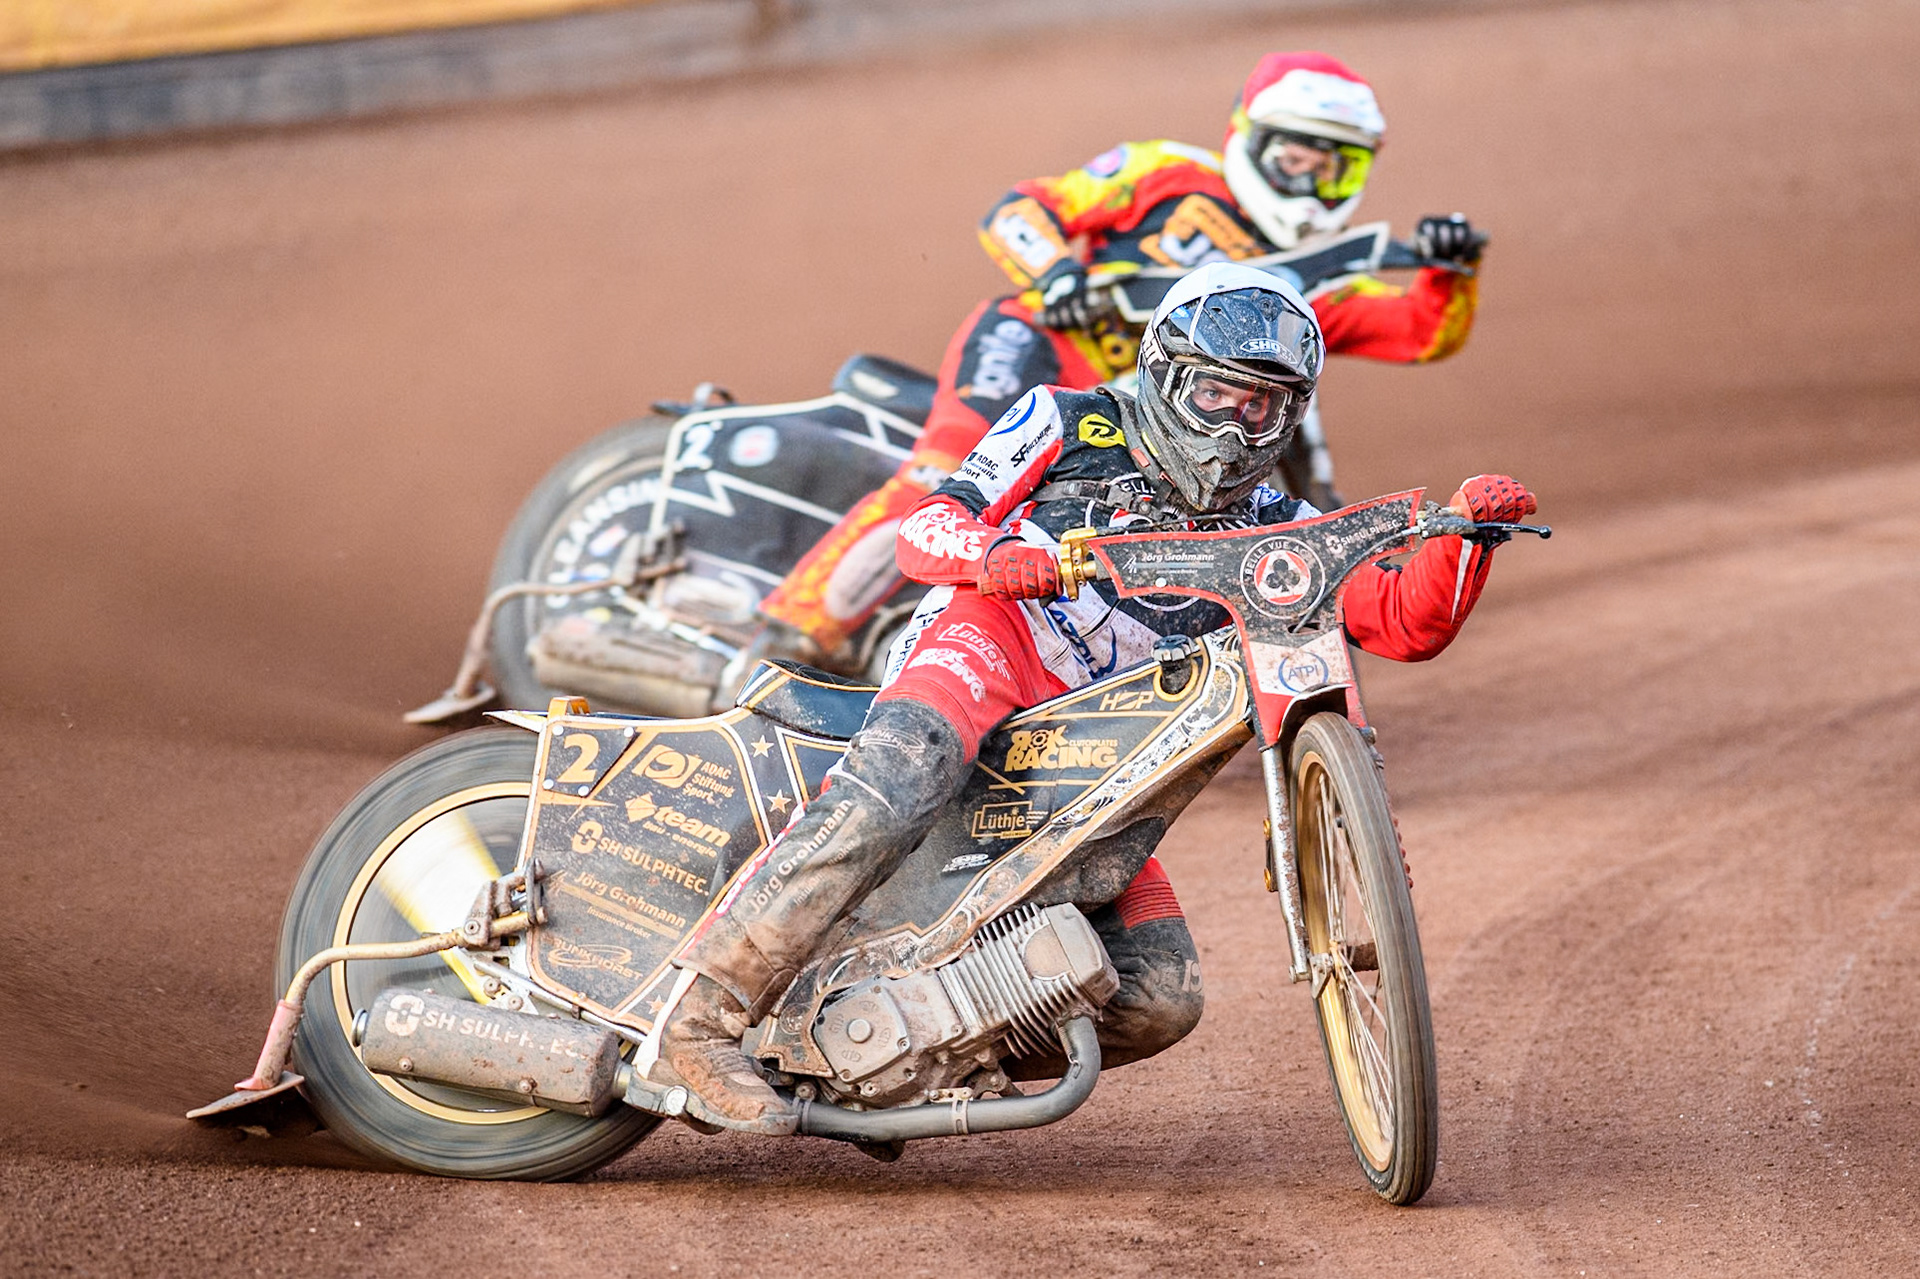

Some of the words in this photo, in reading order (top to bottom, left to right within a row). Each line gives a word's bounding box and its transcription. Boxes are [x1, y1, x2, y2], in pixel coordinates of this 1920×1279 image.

[682, 424, 712, 467] 2
[976, 454, 999, 471] ADAC
[1121, 480, 1156, 494] ELL
[1164, 551, 1215, 562] Grohmann
[1244, 548, 1267, 576] BELLE
[1267, 541, 1289, 551] VUE
[1288, 664, 1319, 682] ATPI
[557, 733, 599, 783] 2
[701, 761, 732, 780] ADAC
[1004, 746, 1118, 772] RACING
[682, 783, 714, 800] Sport
[692, 773, 735, 798] Stiftung
[653, 806, 731, 848] team
[978, 807, 1026, 832] Lüthje
[672, 833, 717, 858] energie
[750, 875, 784, 915] Jörg
[777, 799, 852, 876] Grohmann
[598, 836, 621, 856] SH
[621, 847, 710, 896] SULPHTEC.
[574, 871, 607, 897] Jörg
[609, 886, 687, 929] Grohmann
[587, 906, 625, 929] Insurance
[624, 919, 652, 939] Broker
[423, 1009, 456, 1031] SH
